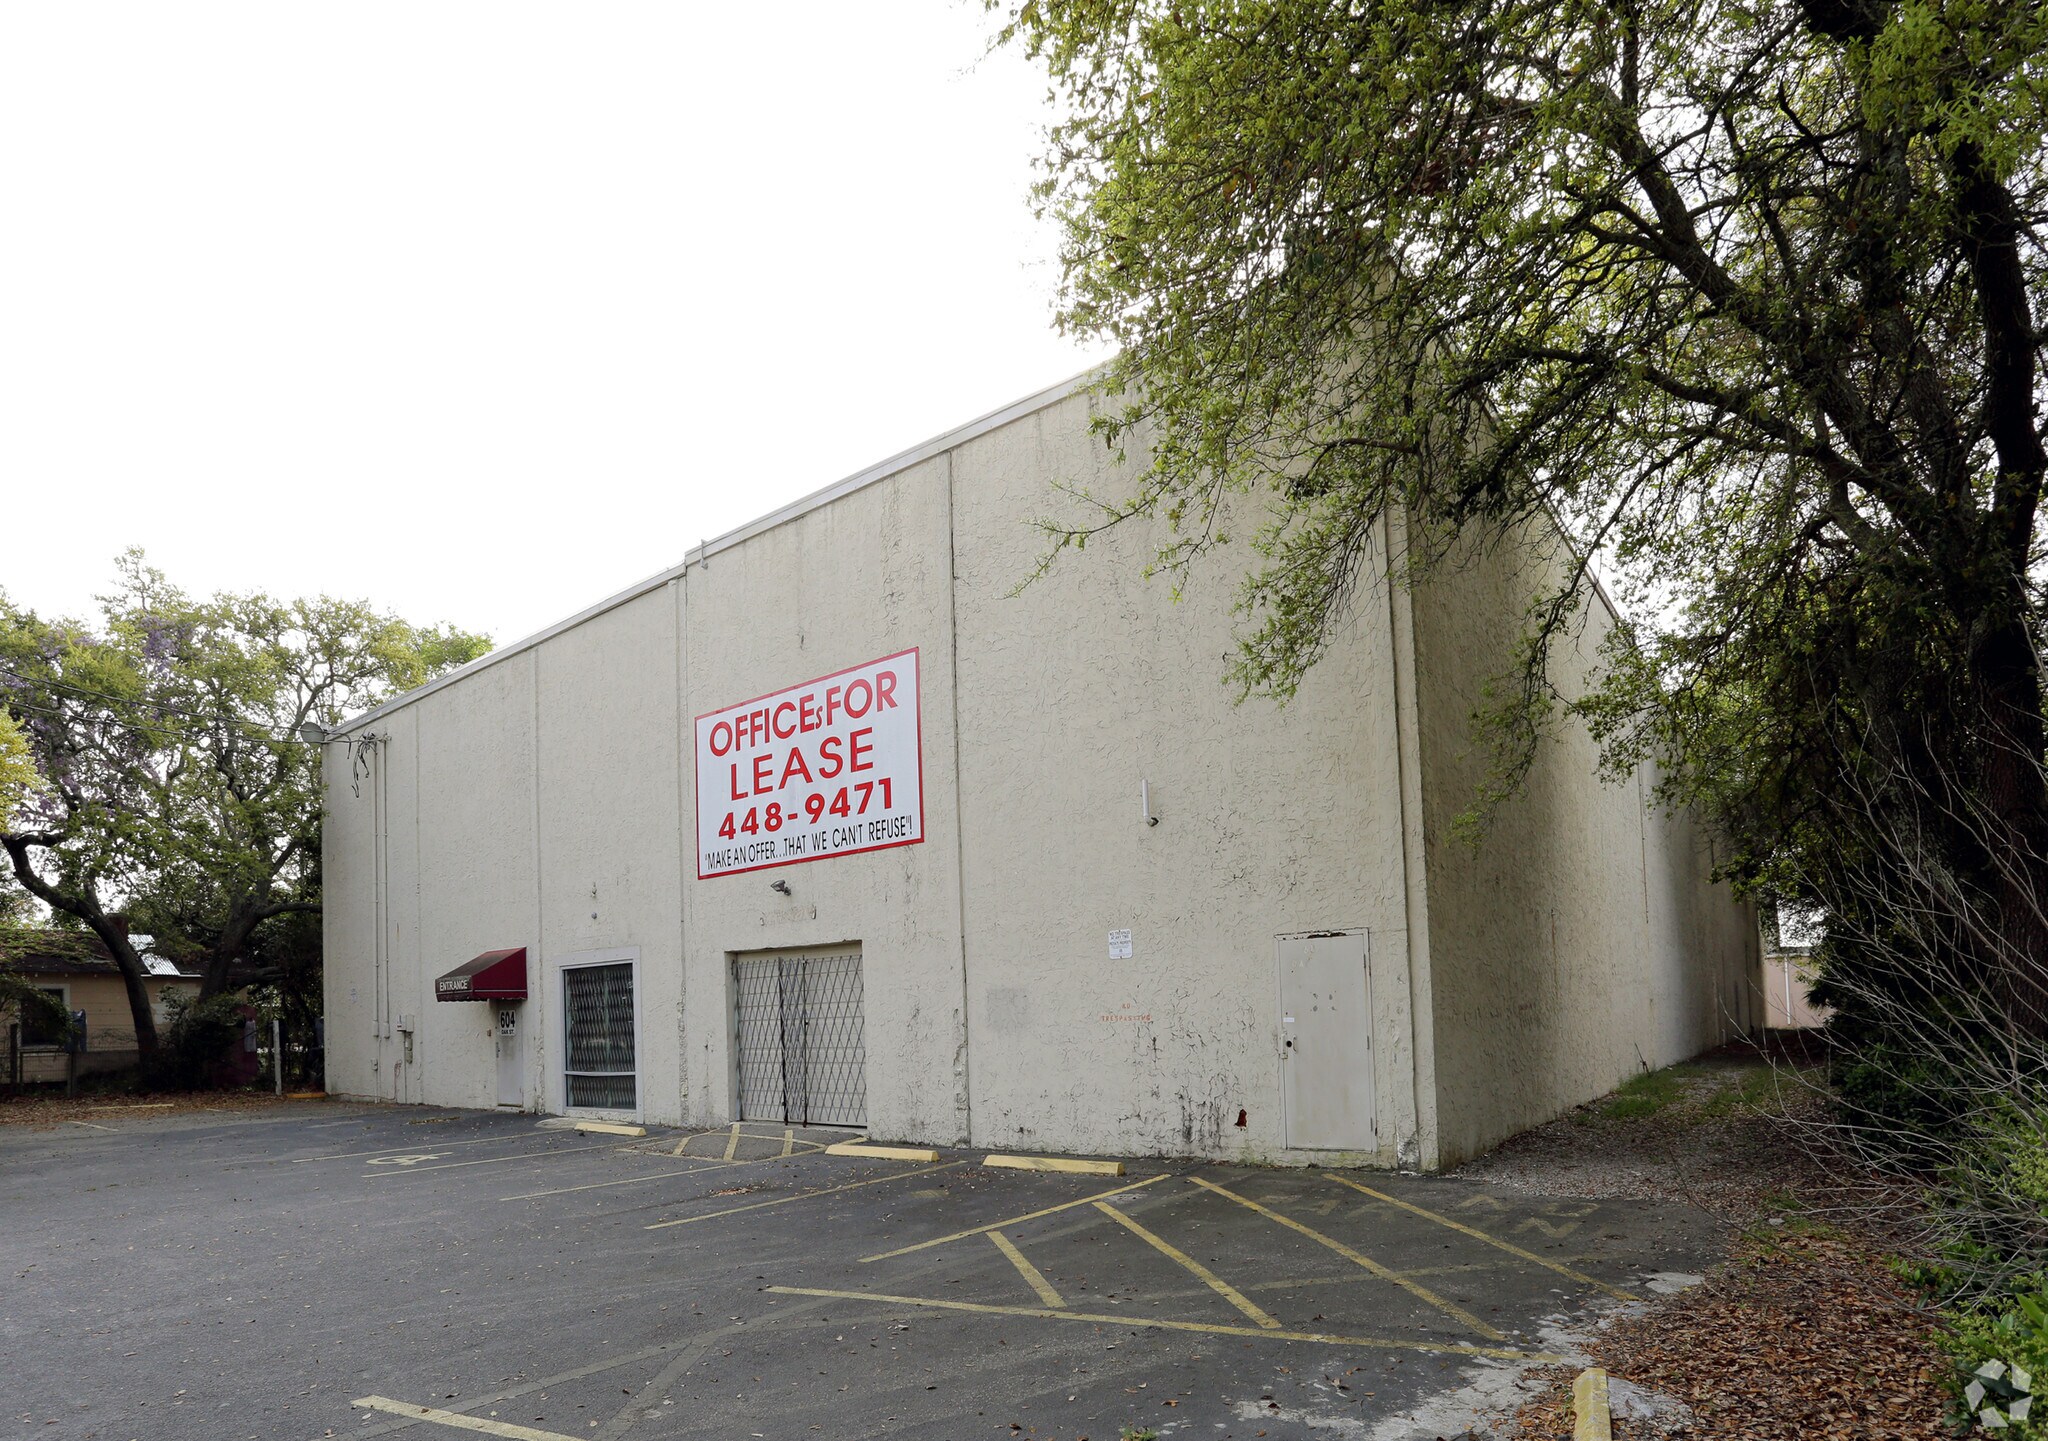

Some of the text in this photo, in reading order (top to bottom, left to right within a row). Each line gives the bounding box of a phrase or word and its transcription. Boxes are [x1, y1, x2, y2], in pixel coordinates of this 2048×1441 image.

[826, 670, 898, 726] FOR
[731, 727, 873, 801] LEASE
[718, 777, 892, 840] 448-9471
[733, 846, 747, 865] AN
[811, 831, 827, 851] WE
[833, 824, 862, 848] CAN'T
[440, 980, 468, 991] ENTRANCE
[500, 1011, 515, 1028] 604
